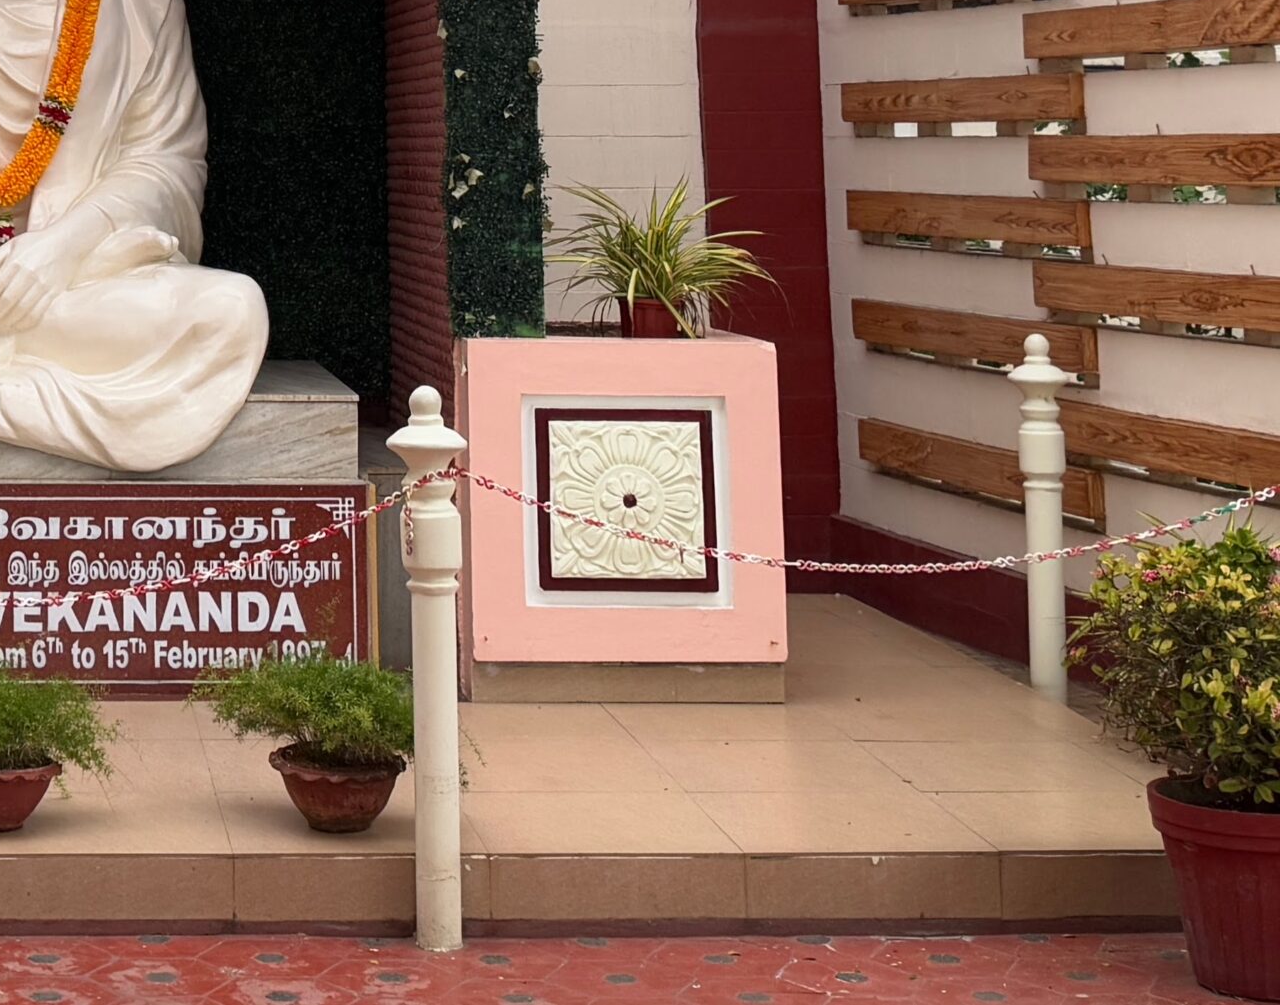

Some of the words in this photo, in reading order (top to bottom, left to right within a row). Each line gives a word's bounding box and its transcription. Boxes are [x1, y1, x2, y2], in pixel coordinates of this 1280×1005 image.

[7, 550, 60, 588] இந்த
[67, 549, 186, 588] இல்லத்தில்
[70, 639, 96, 670] to
[153, 639, 263, 672] February
